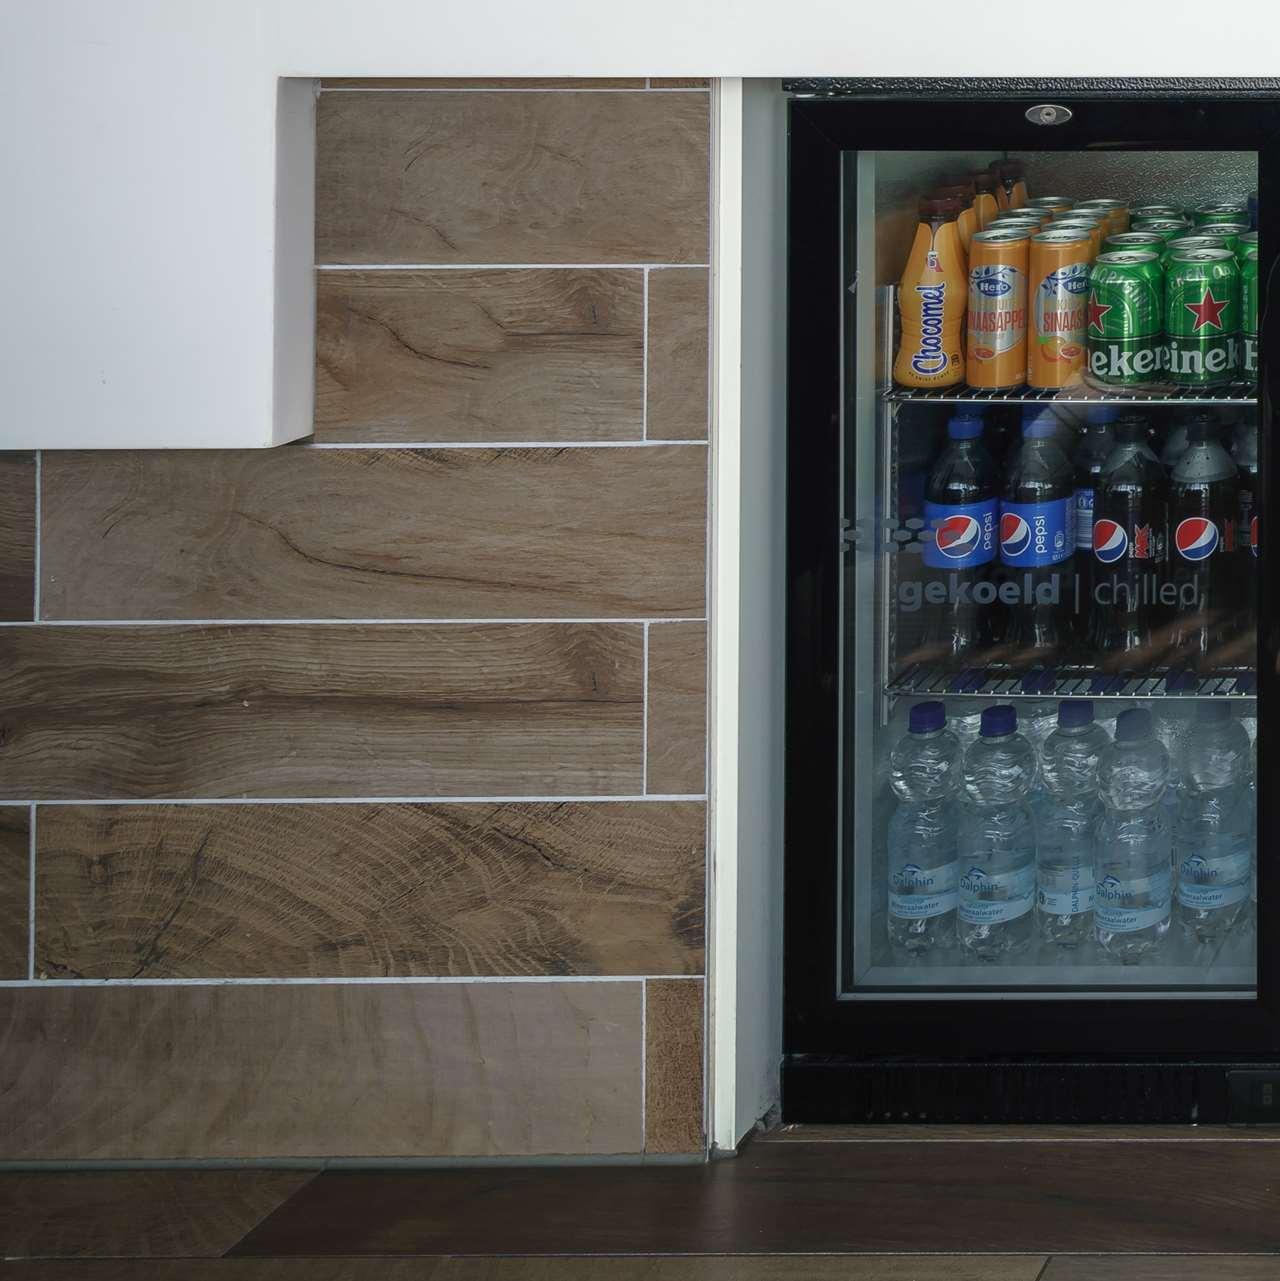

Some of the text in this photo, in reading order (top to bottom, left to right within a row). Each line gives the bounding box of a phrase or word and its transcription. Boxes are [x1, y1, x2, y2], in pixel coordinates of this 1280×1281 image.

[980, 282, 1009, 292] Hero
[1067, 281, 1088, 291] Her
[912, 282, 948, 376] Chocomel
[983, 512, 993, 551] pepsi
[1035, 515, 1047, 554] pepsi
[899, 573, 1199, 613] gekoeld chilled
